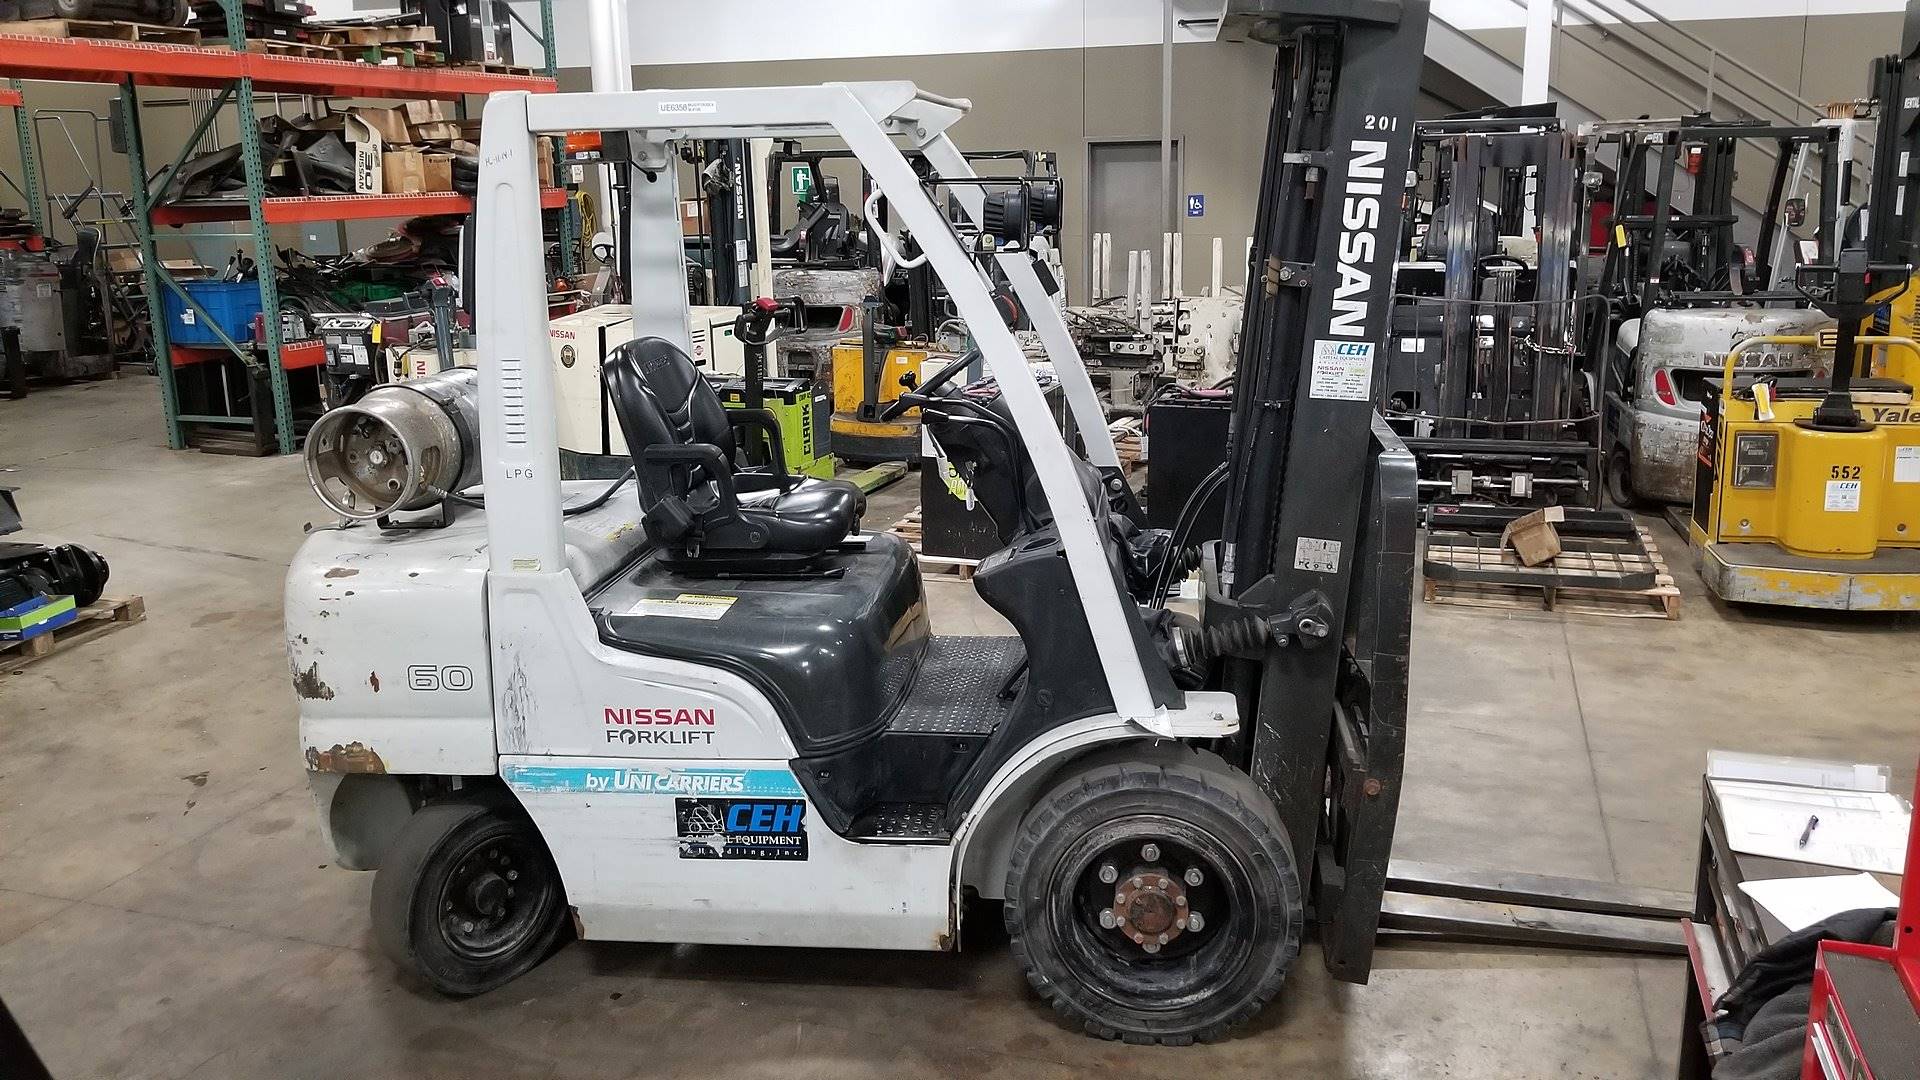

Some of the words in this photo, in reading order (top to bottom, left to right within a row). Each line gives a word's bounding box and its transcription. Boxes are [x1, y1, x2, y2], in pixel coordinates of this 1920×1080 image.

[1364, 115, 1398, 132] 201
[364, 151, 374, 191] 30
[734, 162, 745, 220] NISSAN
[1328, 139, 1388, 337] NISSAN
[549, 329, 575, 340] NISSAN
[1337, 343, 1370, 356] CEH
[1872, 407, 1920, 423] Yale
[801, 403, 811, 456] CLARK
[505, 468, 533, 478] LPG
[1831, 465, 1861, 479] 552
[408, 664, 473, 691] 60
[604, 708, 715, 726] NISSAN
[606, 729, 715, 745] FORKLIFT
[586, 773, 608, 792] by
[726, 804, 803, 833] CEH
[736, 835, 802, 845] EQUIPMENT
